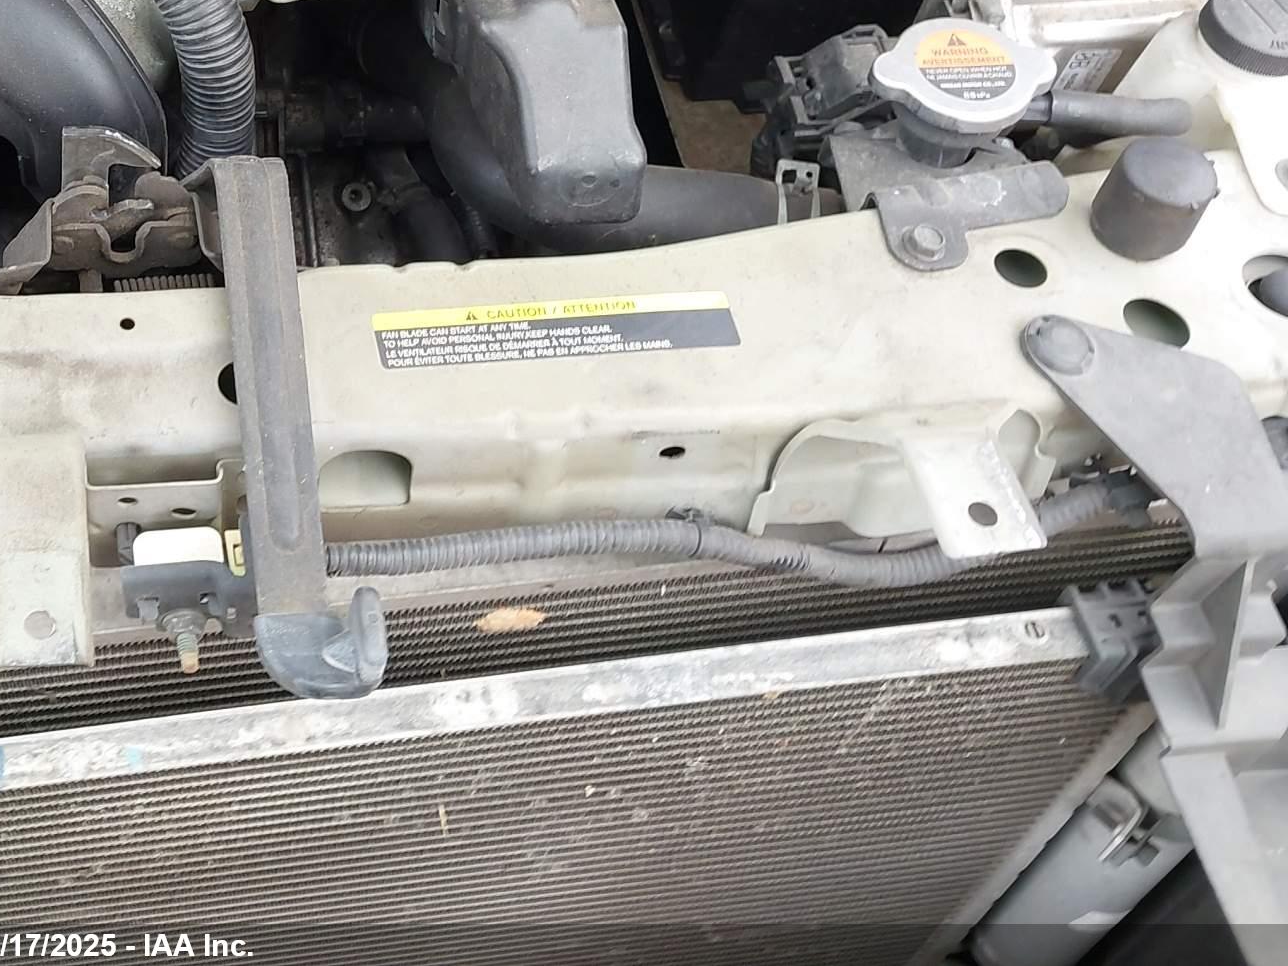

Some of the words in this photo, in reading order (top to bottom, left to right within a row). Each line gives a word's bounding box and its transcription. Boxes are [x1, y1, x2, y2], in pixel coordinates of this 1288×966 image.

[931, 47, 989, 56] WARNING
[487, 306, 547, 320] CAUTION
[563, 300, 637, 314] ATTENTION
[382, 330, 399, 340] FAN
[400, 328, 429, 339] BLADE
[430, 328, 448, 337] CAN
[450, 326, 476, 336] START
[477, 325, 489, 334] AT
[490, 323, 509, 333] ANY
[383, 339, 396, 349] TO
[397, 338, 420, 348] HELP
[421, 336, 448, 346] AVOID
[449, 334, 495, 345] PERSONAL
[549, 327, 580, 337] HANDS
[386, 349, 397, 359] LE
[397, 346, 454, 358] VENTILATEUR
[455, 344, 487, 355] RISQUE
[489, 343, 502, 352] DE
[561, 336, 581, 346] TOUT
[387, 358, 413, 368] POUR
[445, 353, 474, 364] TOUTE
[475, 350, 522, 362] BLESSURE,
[523, 349, 536, 358] NE
[537, 347, 554, 357] PAS
[556, 345, 569, 355] EN
[570, 342, 624, 355] APPROCHER
[625, 341, 642, 351] LES
